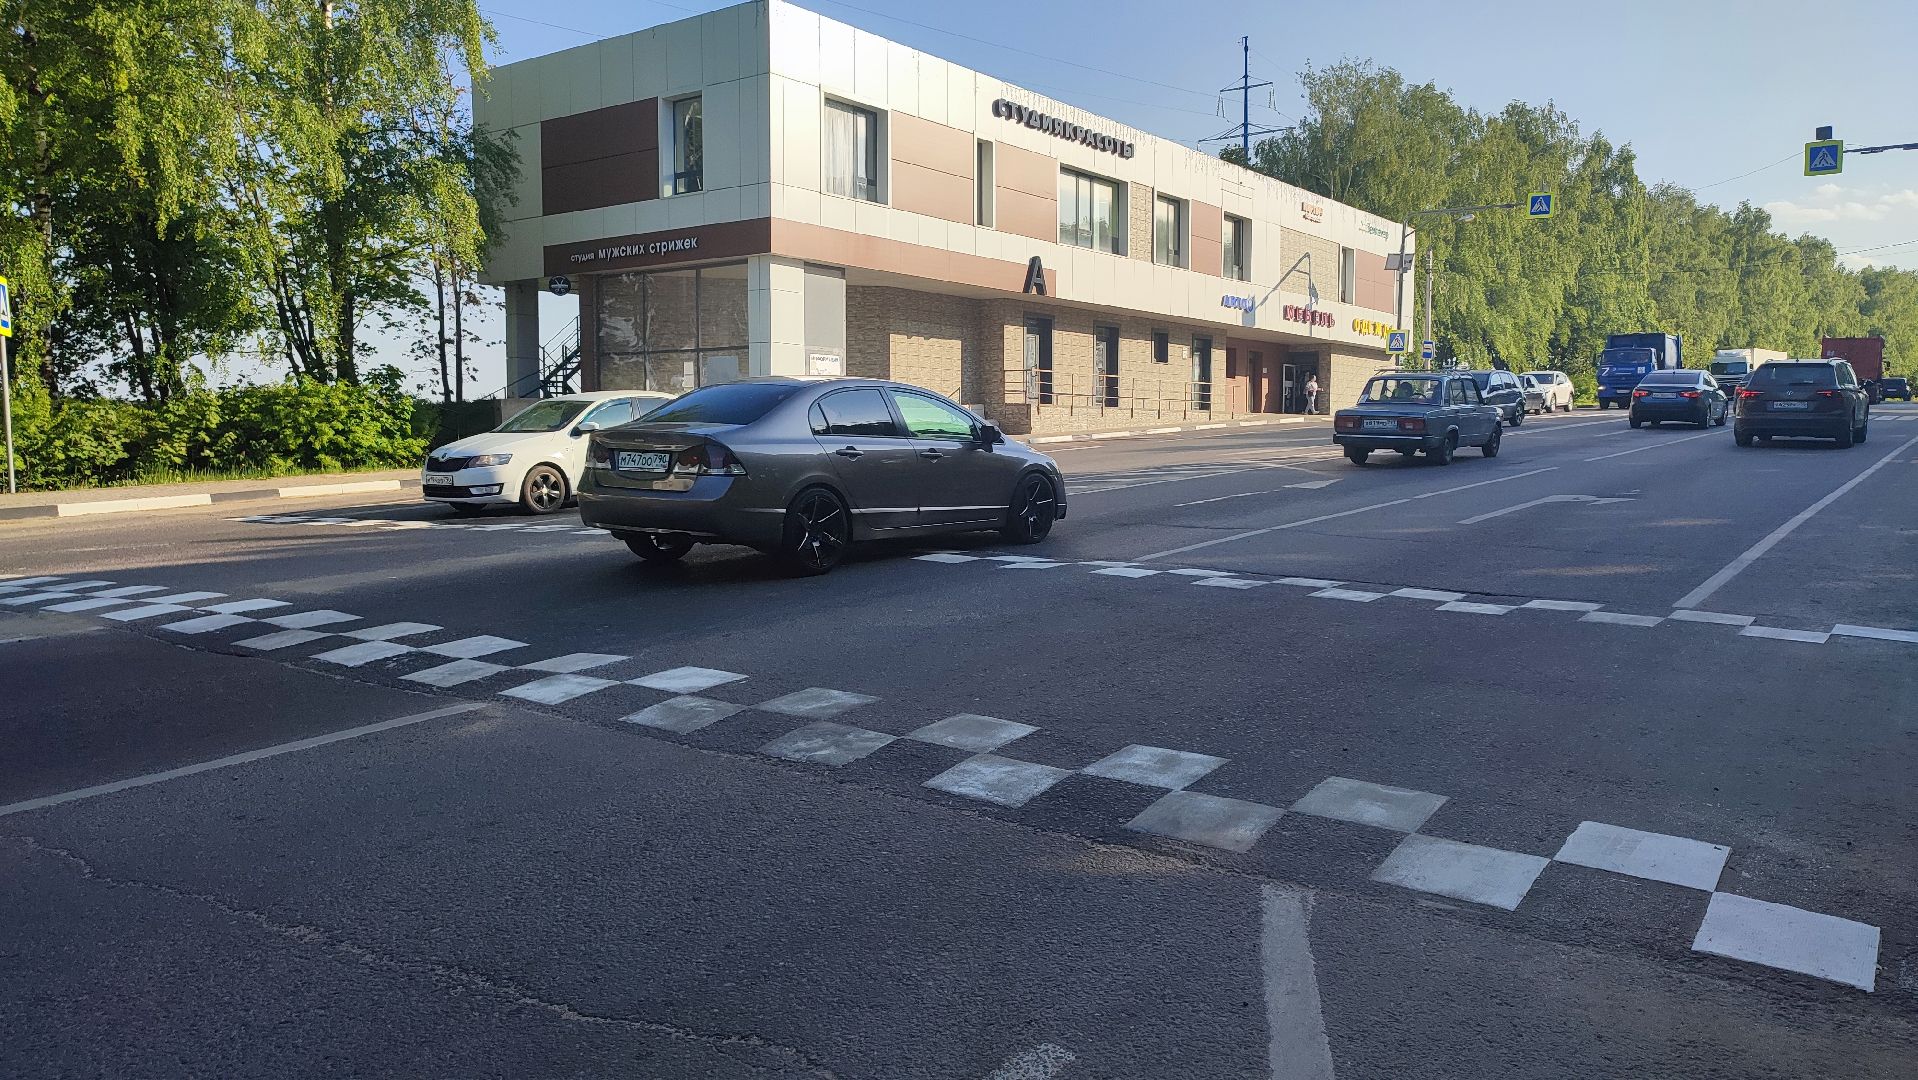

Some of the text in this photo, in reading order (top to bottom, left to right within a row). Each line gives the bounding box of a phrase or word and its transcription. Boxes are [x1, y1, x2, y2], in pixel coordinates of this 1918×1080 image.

[570, 236, 698, 263] студия мужских стрижек
[1283, 304, 1335, 328] МЕБЕЛЬ
